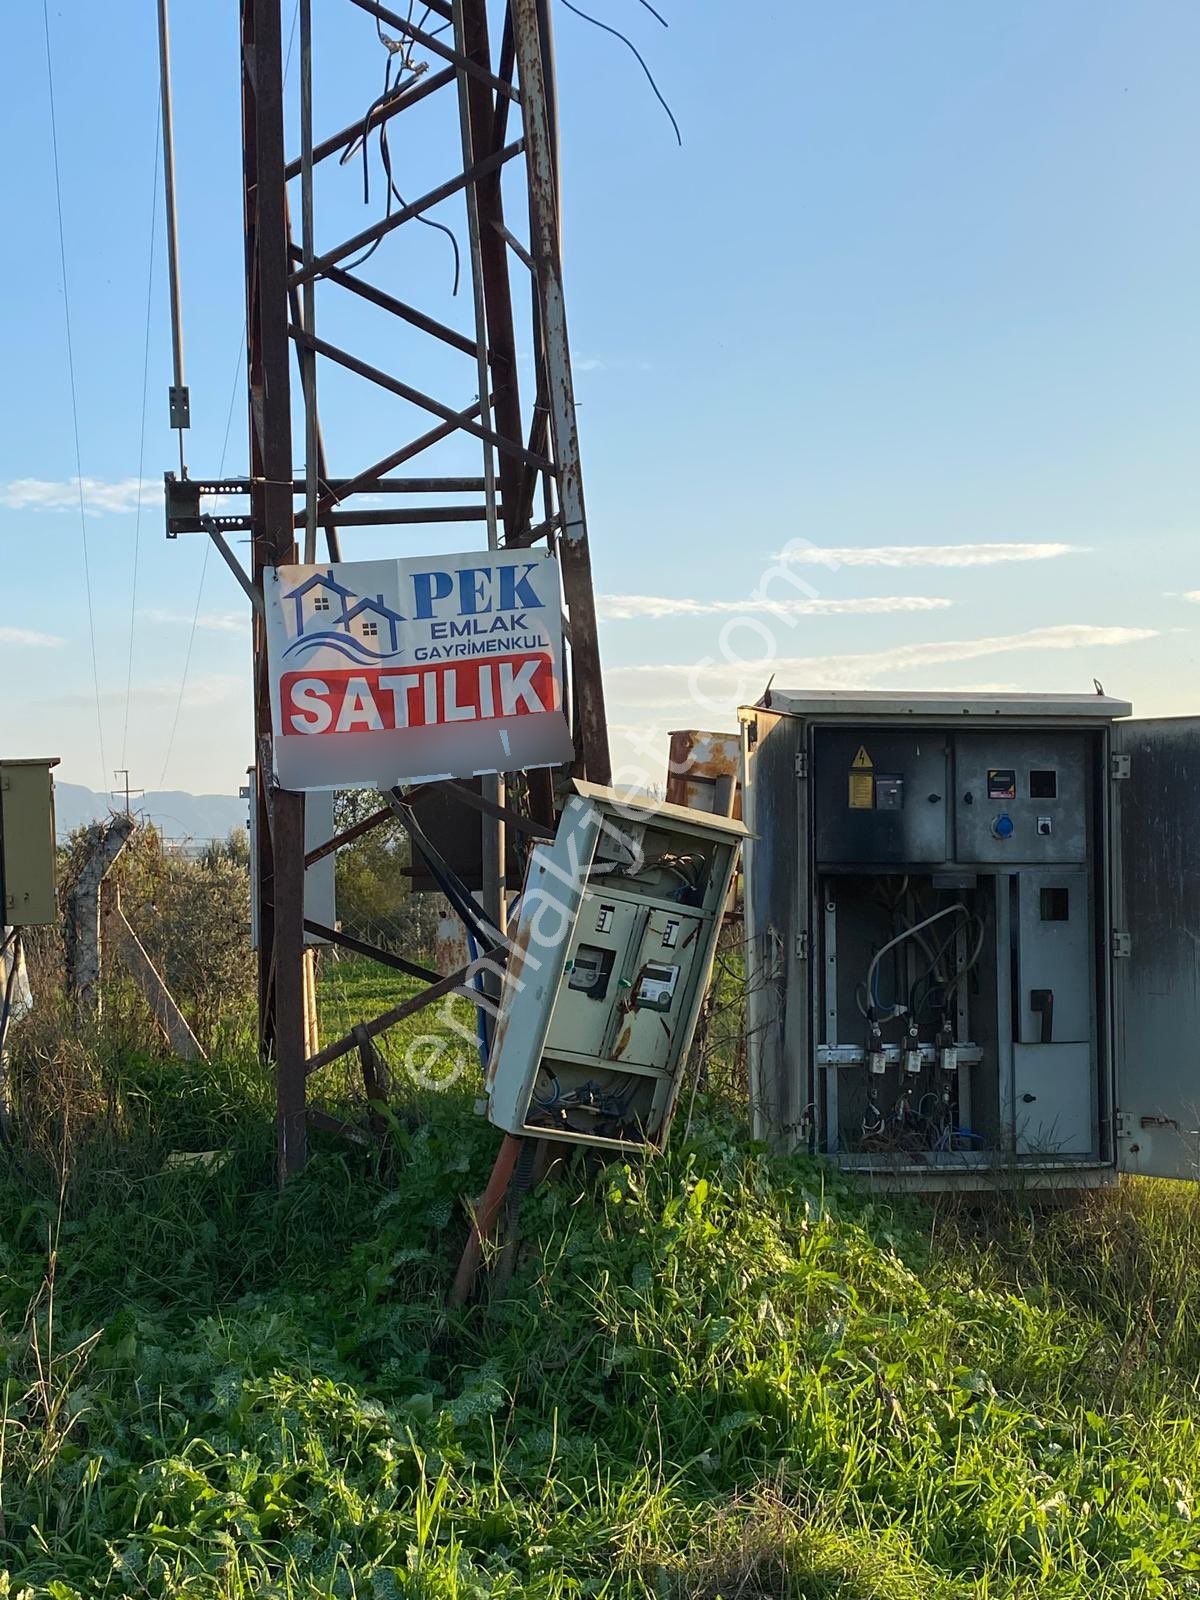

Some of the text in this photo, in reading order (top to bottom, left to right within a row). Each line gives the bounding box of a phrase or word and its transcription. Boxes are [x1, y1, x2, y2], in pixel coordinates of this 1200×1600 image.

[409, 563, 546, 620] PEK
[414, 634, 549, 661] GAYRİMENKUL
[431, 613, 528, 640] EMLAK
[290, 659, 547, 735] SATILIK
